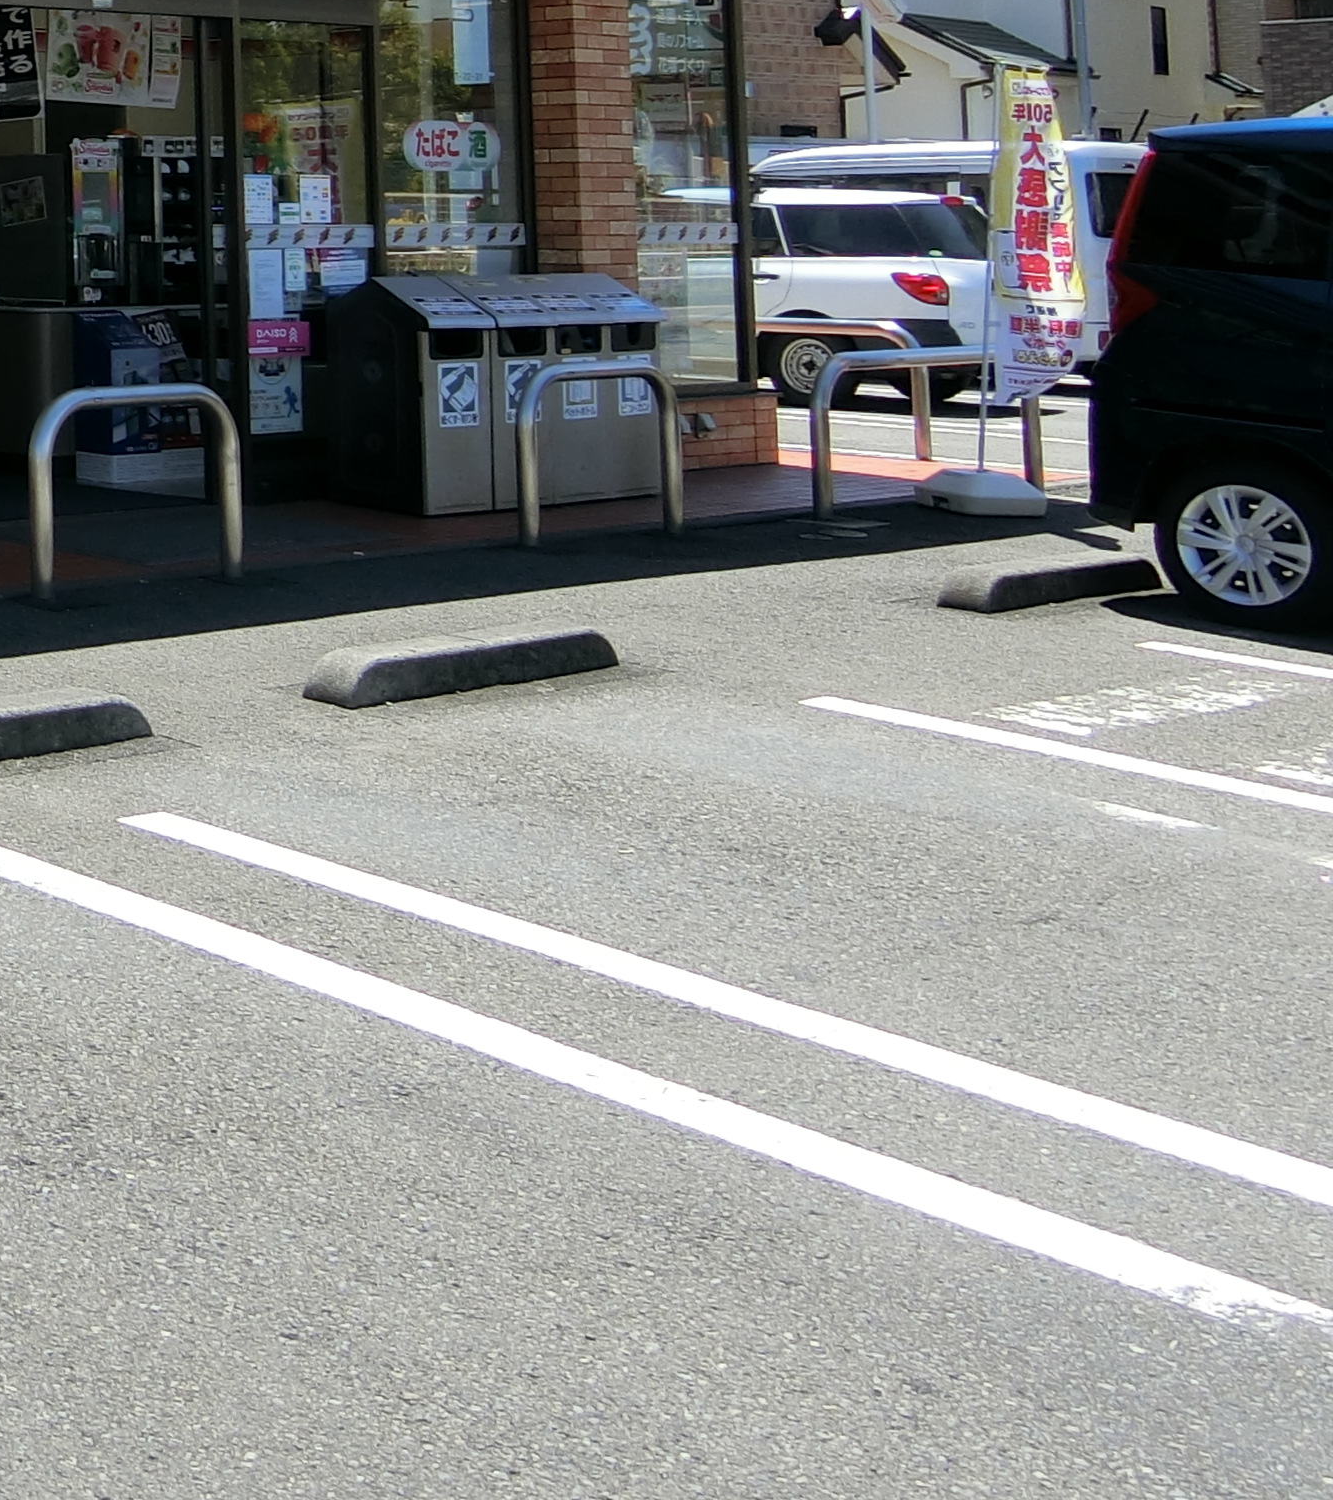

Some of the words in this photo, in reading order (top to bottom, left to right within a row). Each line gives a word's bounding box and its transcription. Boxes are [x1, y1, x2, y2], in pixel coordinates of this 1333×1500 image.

[415, 127, 461, 158] たばこ
[467, 129, 488, 159] 酒
[255, 329, 288, 339] DAISO
